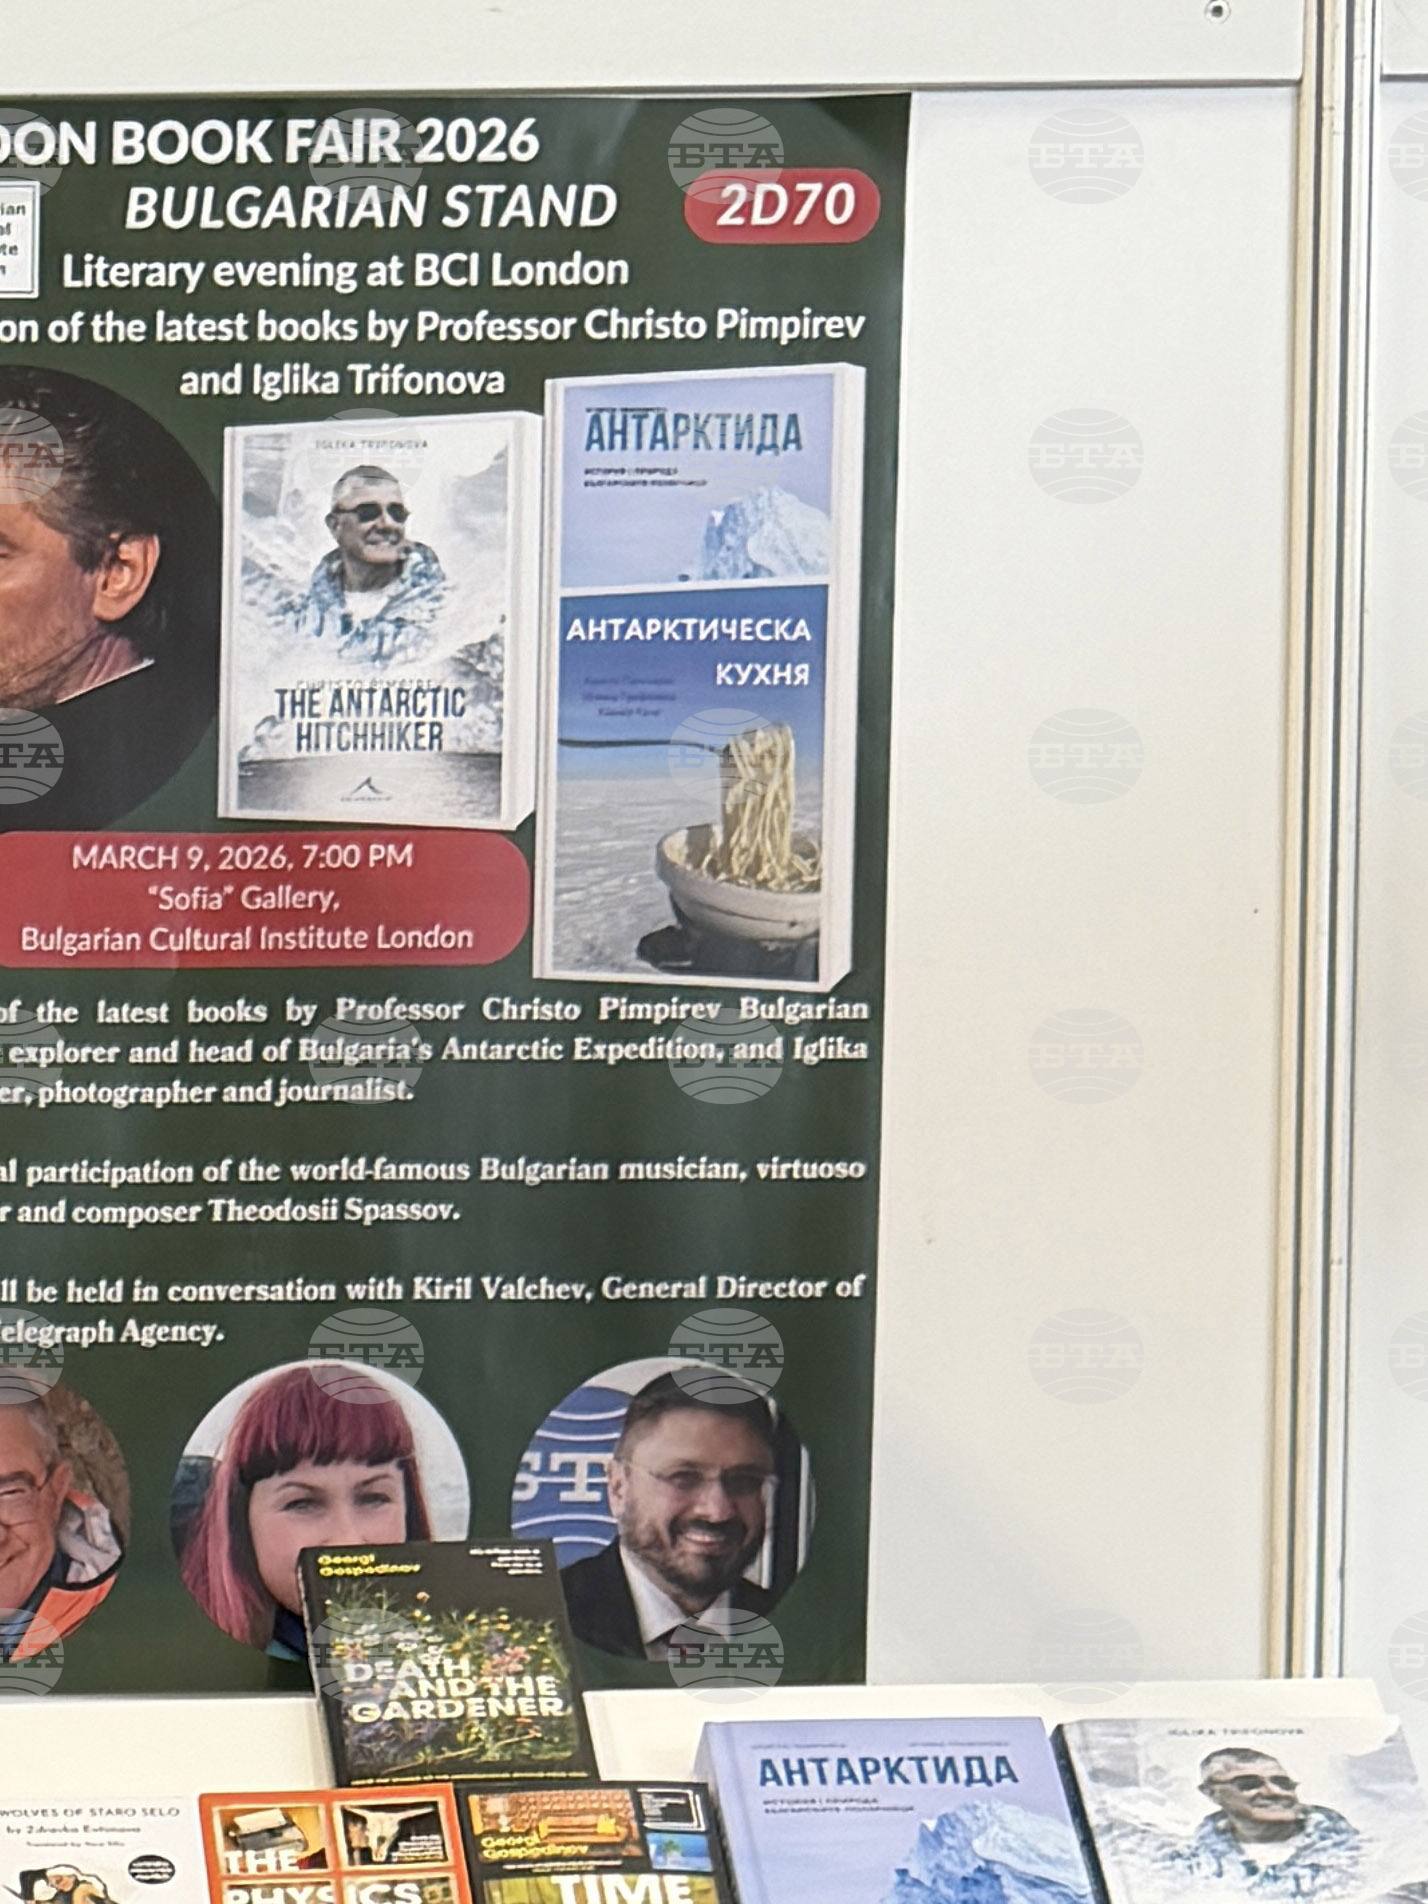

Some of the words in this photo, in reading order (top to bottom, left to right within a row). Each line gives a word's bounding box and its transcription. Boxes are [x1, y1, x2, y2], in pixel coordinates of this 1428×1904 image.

[112, 119, 273, 164] BOOK
[286, 118, 402, 163] FAIR
[414, 117, 540, 163] 2026
[125, 185, 428, 229] BULGARIAN
[442, 184, 617, 228] STAND
[716, 182, 855, 225] 2D70
[63, 253, 206, 294] Literary
[213, 252, 358, 294] evening
[366, 255, 404, 287] at
[415, 252, 479, 287] BCI
[492, 250, 629, 286] London
[47, 310, 85, 343] of
[90, 310, 147, 343] the
[156, 309, 249, 342] latest
[257, 309, 358, 341] books
[367, 309, 409, 348] by
[417, 309, 577, 342] Professor
[584, 307, 707, 340] Christo
[716, 307, 866, 346] Pimpirev
[179, 362, 242, 395] and
[253, 362, 340, 401] Iglika
[347, 363, 505, 395] Trifonova
[584, 408, 803, 456] АНТАРКТИДА
[566, 615, 811, 643] АНТАРКТИЧЕСКА
[715, 661, 809, 686] КУХНЯ
[275, 688, 322, 718] THE
[329, 686, 466, 718] ANTARCTIC
[295, 720, 444, 752] HITCHHIKER
[72, 844, 179, 870] MARCH
[187, 845, 210, 872] 9,
[218, 844, 294, 870] 2026,
[302, 844, 361, 869] 7:00
[369, 843, 413, 868] PM
[148, 885, 234, 911] “Sofia”
[241, 884, 340, 913] Gallery,
[21, 925, 141, 957] Bulgarian
[149, 926, 252, 952] Cultural
[260, 925, 369, 950] Institute
[377, 923, 474, 949] London
[17, 1199, 66, 1223] and
[71, 1204, 203, 1229] composer
[207, 1197, 339, 1222] Theodosii
[344, 1197, 461, 1226] Spassov.
[346, 1659, 470, 1684] DEATH
[388, 1677, 483, 1700] AND
[488, 1676, 558, 1697] THE
[352, 1698, 565, 1723] GARDENER
[759, 1755, 1019, 1788] АНТАРКТИДА
[224, 1849, 301, 1874] THE
